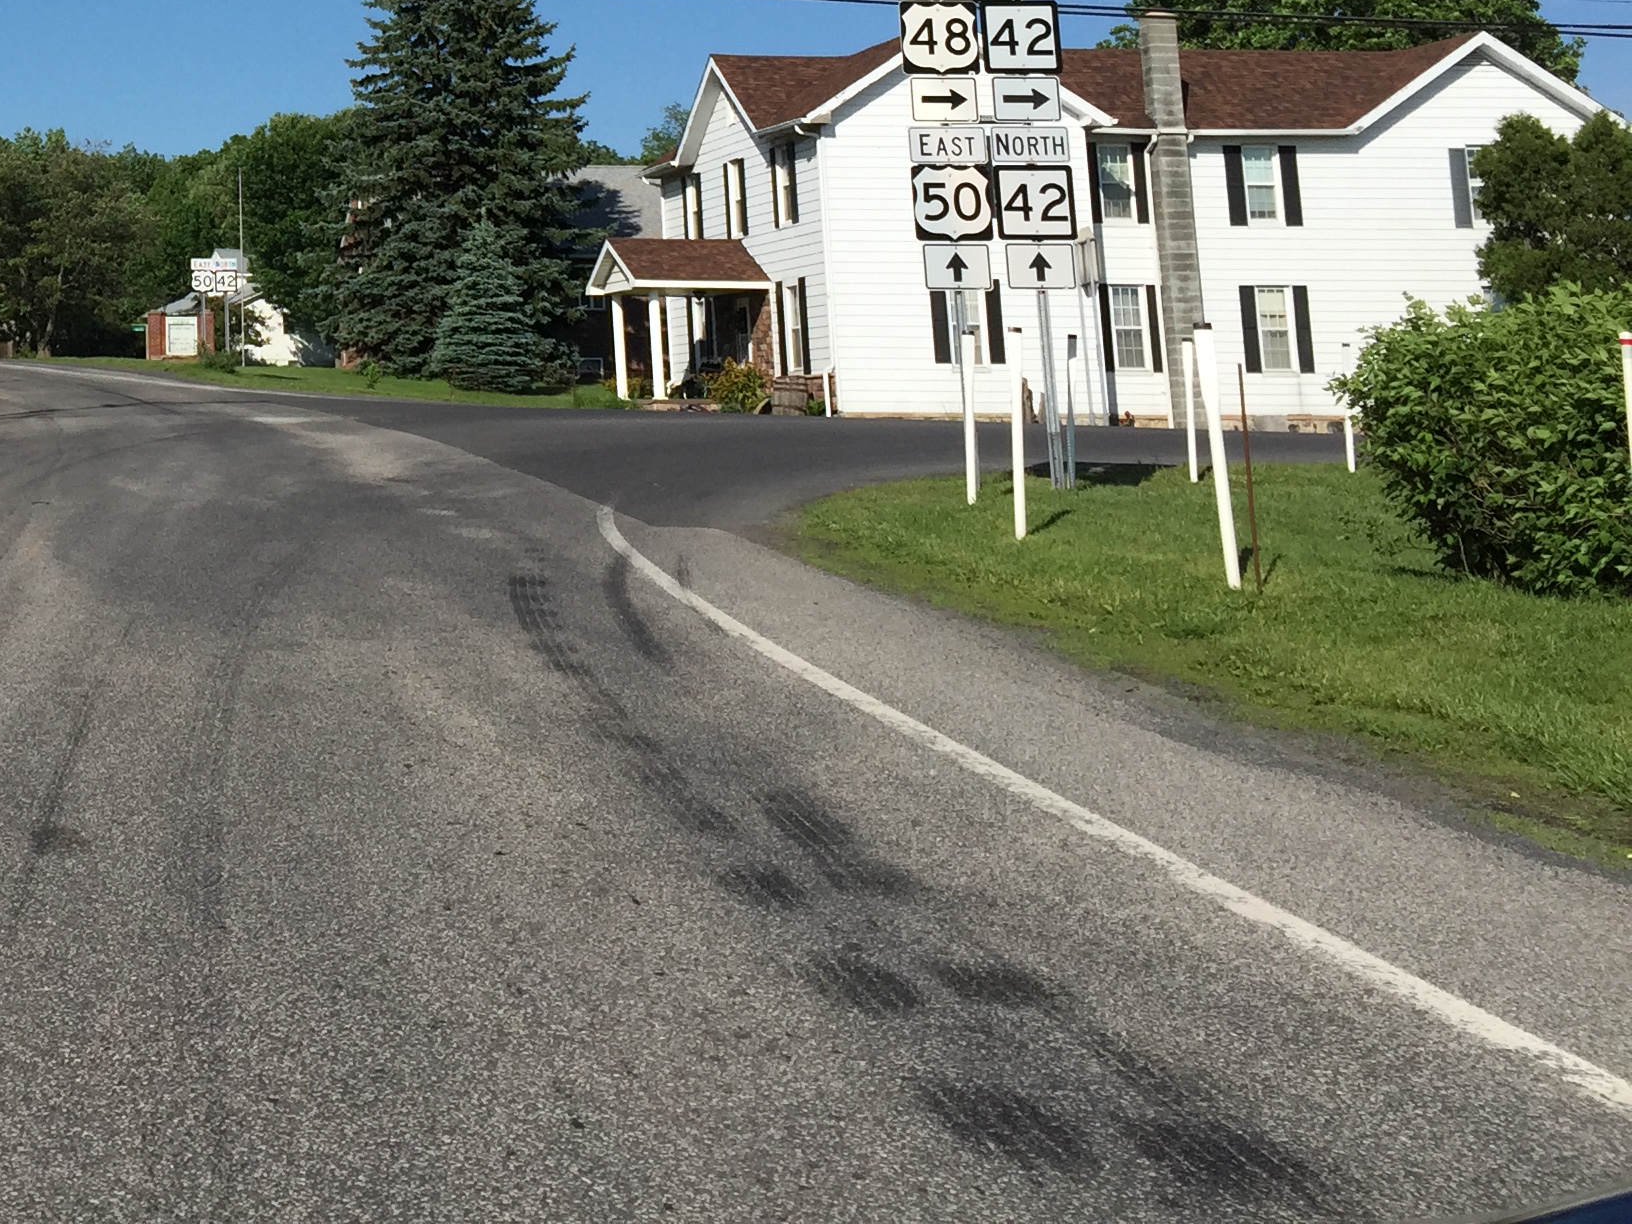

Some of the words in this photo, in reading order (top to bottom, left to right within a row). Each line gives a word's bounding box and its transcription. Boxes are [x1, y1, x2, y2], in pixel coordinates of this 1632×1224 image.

[909, 17, 971, 56] 48
[989, 17, 1054, 56] 42
[919, 133, 975, 157] EAST
[995, 133, 1066, 156] NORTH
[922, 181, 982, 222] 50
[1003, 182, 1069, 222] 42
[194, 275, 212, 287] 50
[217, 275, 236, 287] 42
